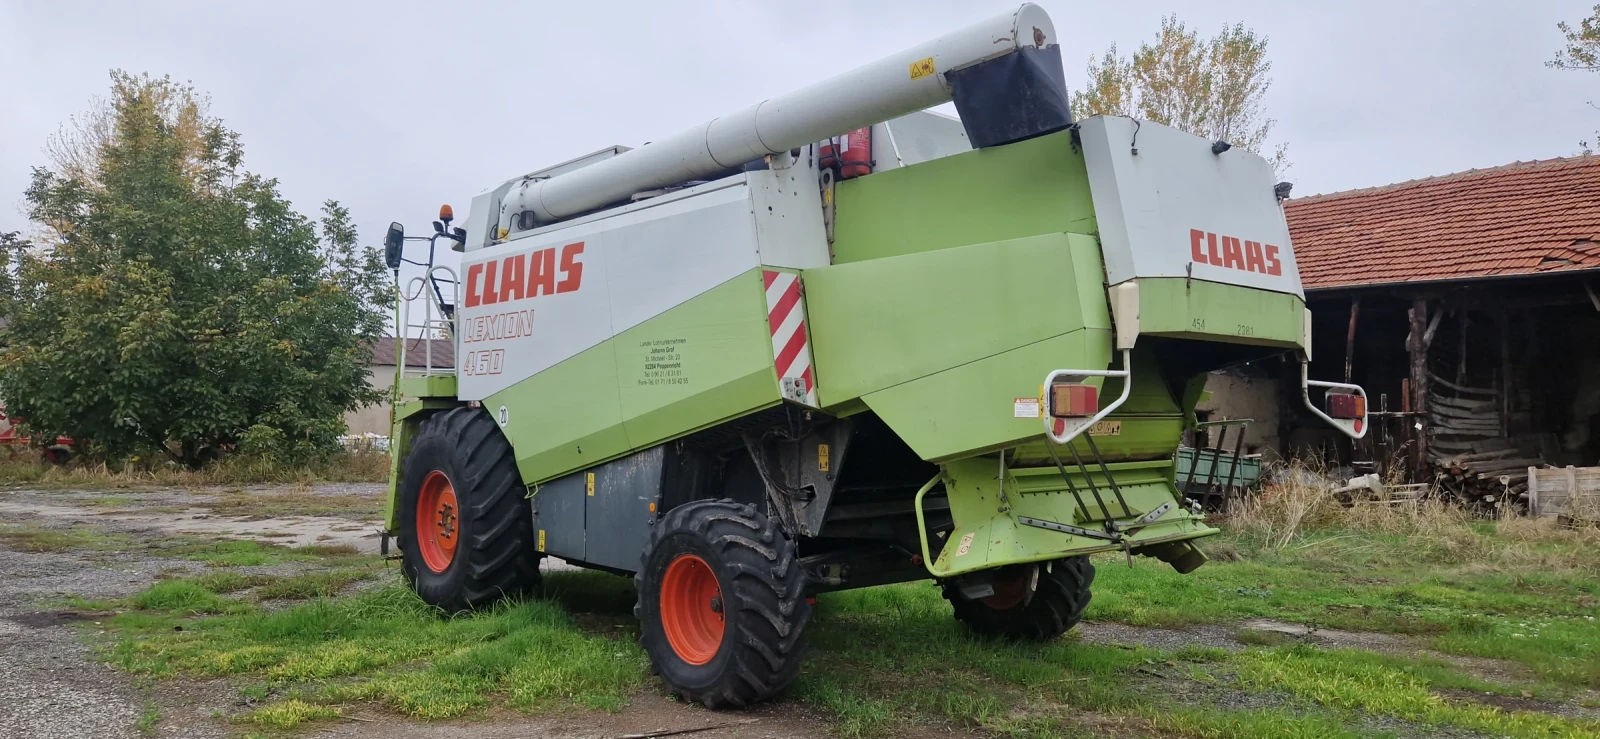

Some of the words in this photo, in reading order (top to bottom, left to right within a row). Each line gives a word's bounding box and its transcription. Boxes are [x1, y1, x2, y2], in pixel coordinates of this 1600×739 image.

[1190, 228, 1282, 276] CLAAS
[465, 241, 585, 308] CLAAS
[464, 309, 534, 343] LEXION
[1192, 318, 1205, 330] 454
[464, 349, 505, 376] 460
[657, 362, 681, 370] Poppenricht
[501, 408, 507, 424] 20
